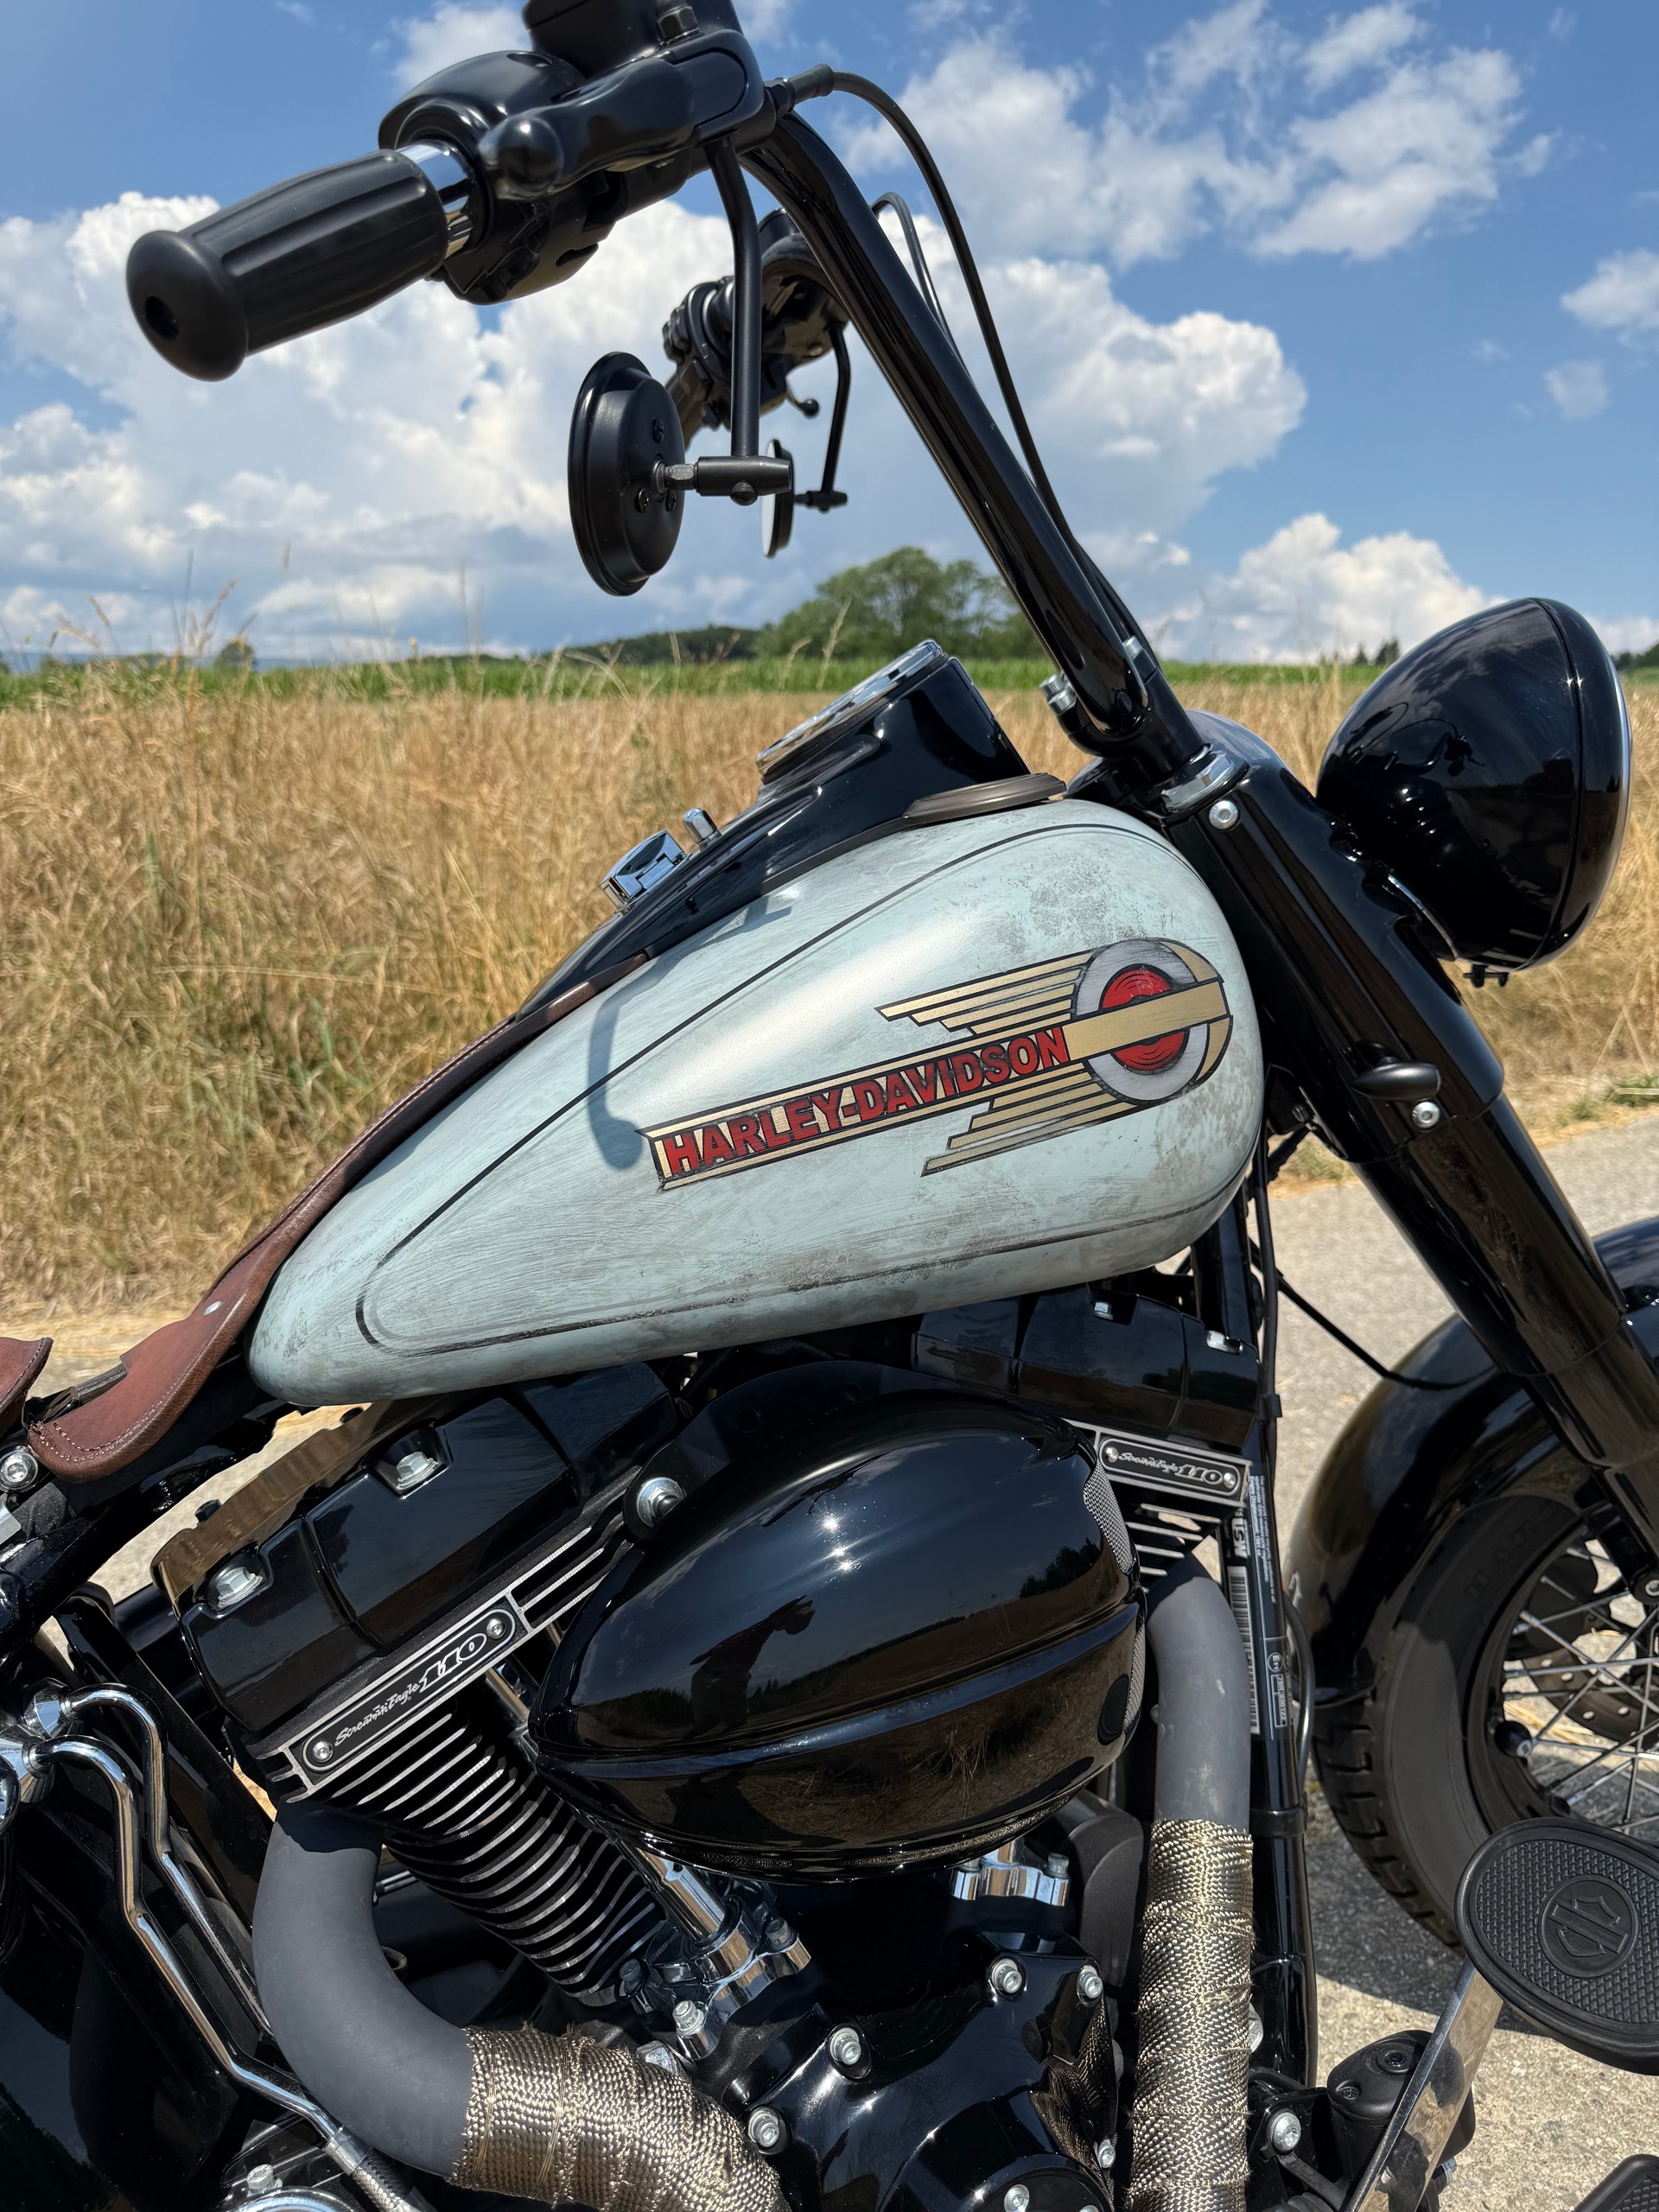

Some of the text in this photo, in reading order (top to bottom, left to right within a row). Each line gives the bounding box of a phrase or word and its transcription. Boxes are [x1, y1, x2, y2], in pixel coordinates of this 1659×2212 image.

[663, 1025, 1069, 1176] HARLEY-DAVIDSON
[1174, 1464, 1224, 1485] 110
[386, 1681, 420, 1713] Eagle
[418, 1632, 487, 1694] 110
